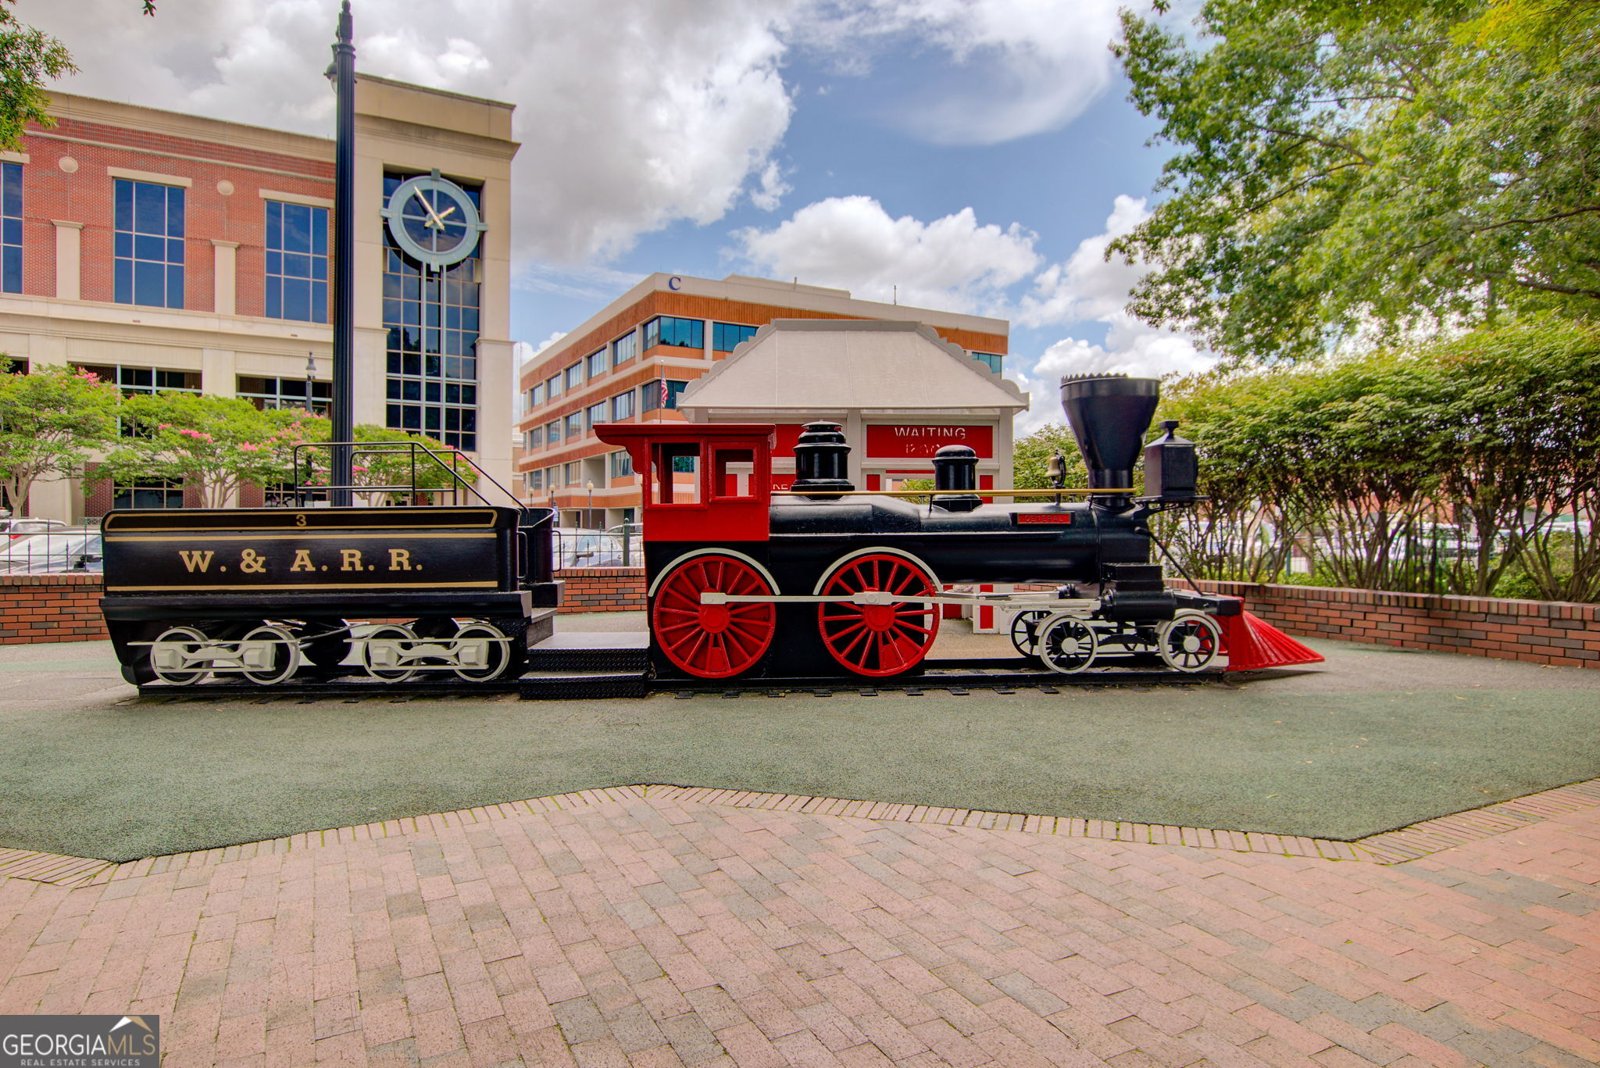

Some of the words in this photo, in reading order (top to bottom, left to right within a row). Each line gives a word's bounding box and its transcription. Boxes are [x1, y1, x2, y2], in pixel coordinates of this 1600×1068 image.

[668, 276, 681, 291] C
[894, 426, 966, 440] WAITING
[295, 513, 307, 527] 3
[239, 548, 267, 573] &
